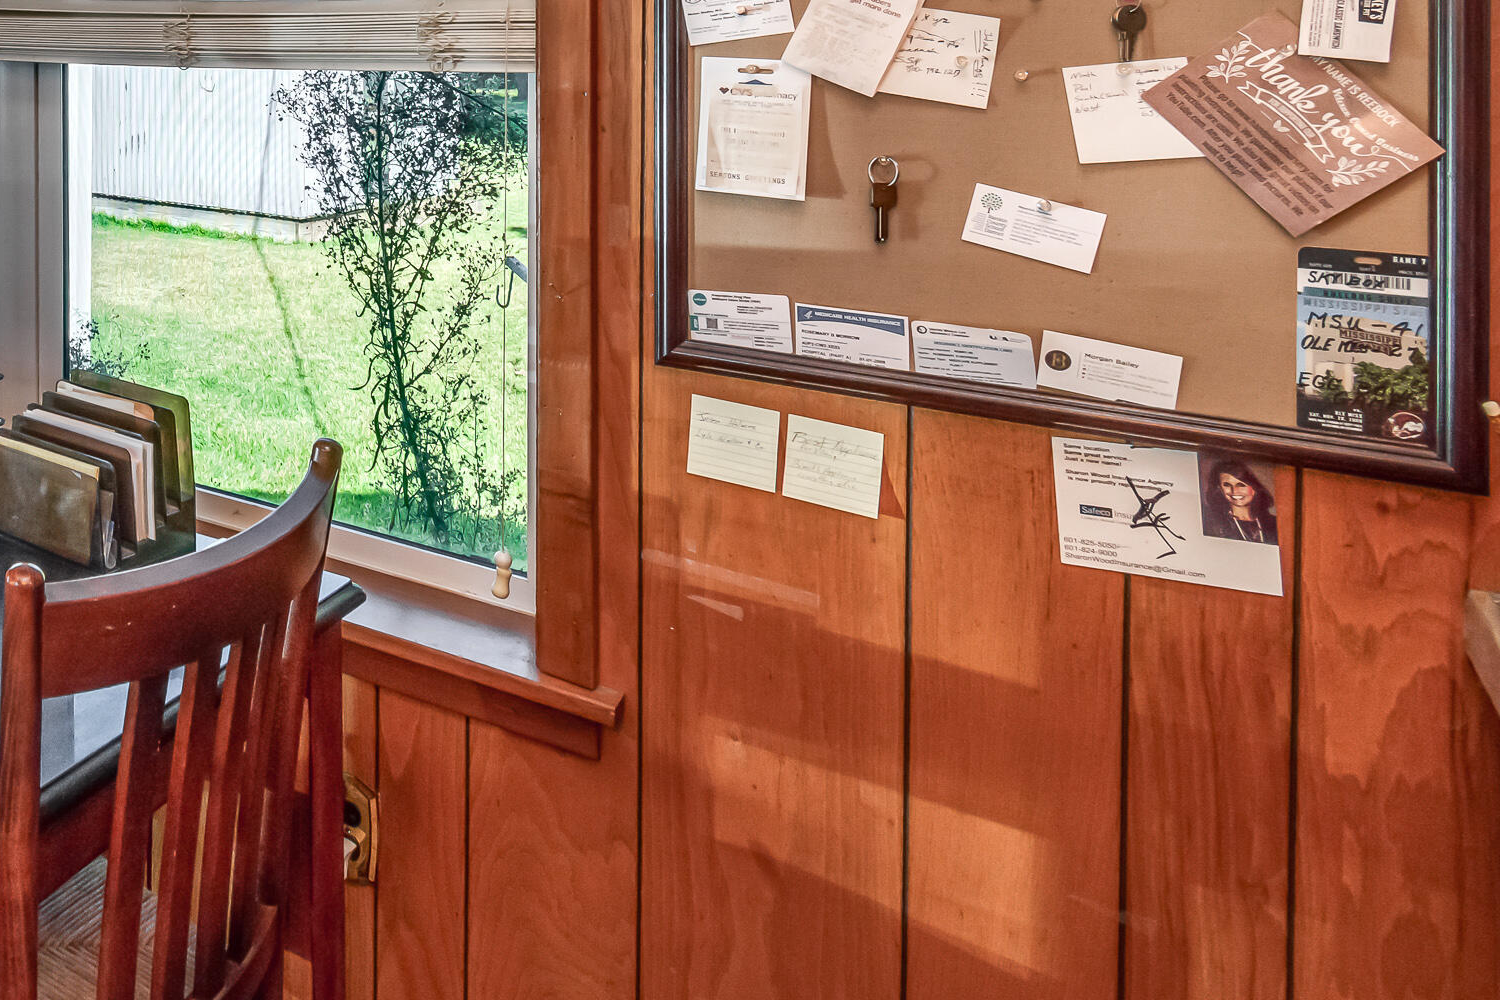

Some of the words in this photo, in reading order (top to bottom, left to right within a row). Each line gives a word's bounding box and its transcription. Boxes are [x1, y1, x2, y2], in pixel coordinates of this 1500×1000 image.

[861, 1, 882, 11] more
[882, 7, 901, 18] done
[1334, 0, 1344, 21] CLASSIC
[1331, 21, 1342, 49] SANDWICH
[730, 86, 753, 96] CVS
[1322, 63, 1354, 95] NAME
[1347, 85, 1361, 99] IS
[1356, 92, 1401, 128] REEBOCK
[1244, 45, 1320, 118] thank
[1312, 111, 1370, 157] you
[1219, 142, 1235, 154] you
[709, 170, 741, 180] SEAONS
[1392, 255, 1417, 265] GAME
[1307, 269, 1342, 286] SKY
[1346, 275, 1386, 290] BOX
[866, 316, 900, 327] INSURANCE
[1305, 310, 1364, 332] MSU
[1390, 320, 1423, 337] 41
[1300, 333, 1334, 353] OLE
[1083, 352, 1113, 364] Morgan
[1115, 358, 1140, 369] Bailey
[1297, 371, 1342, 391] EGG
[1111, 474, 1145, 483] Insuance
[1081, 505, 1111, 517] Safeco
[1064, 552, 1206, 579] SharonWoodInsurance@Gmail.com
